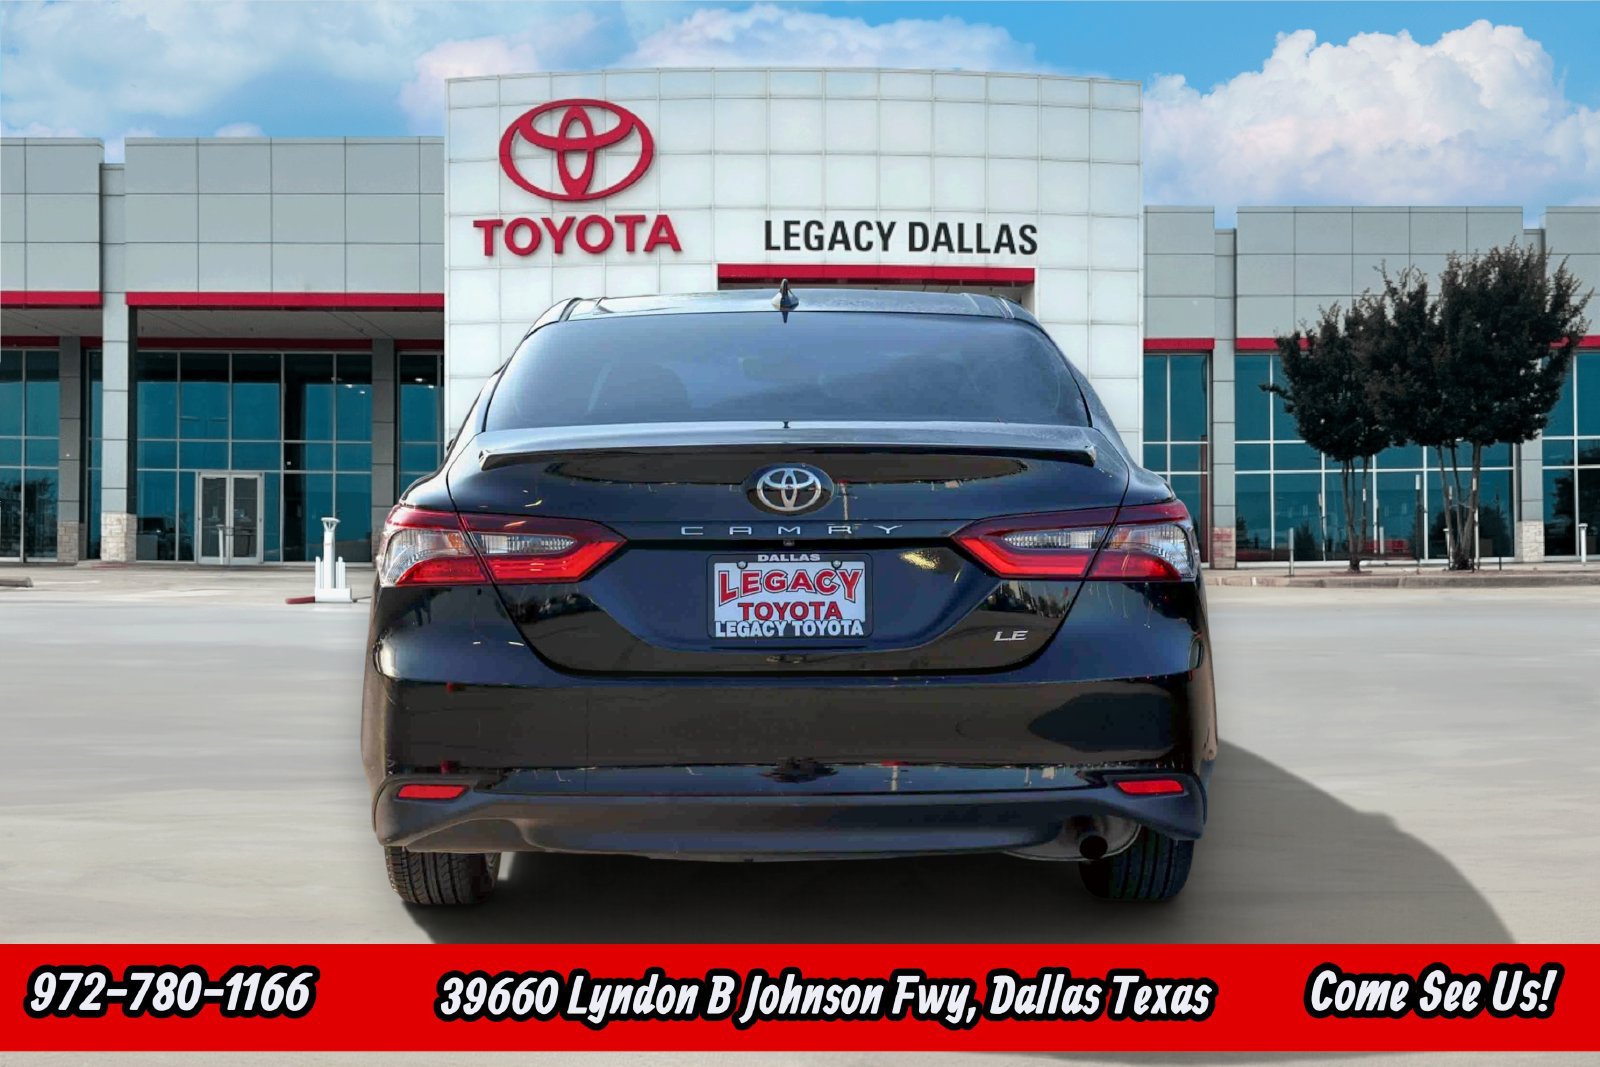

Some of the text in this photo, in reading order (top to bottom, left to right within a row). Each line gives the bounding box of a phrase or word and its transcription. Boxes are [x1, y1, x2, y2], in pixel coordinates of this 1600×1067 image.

[473, 214, 682, 257] TOYOTA
[765, 220, 1038, 255] LEGACY DALLAS
[680, 525, 903, 536] CAMRY
[757, 553, 821, 562] DALLAS
[718, 568, 864, 606] LEGACY
[737, 601, 843, 621] TOYOTA
[715, 619, 864, 638] LEGACY TOYOTA
[993, 630, 1028, 642] LE
